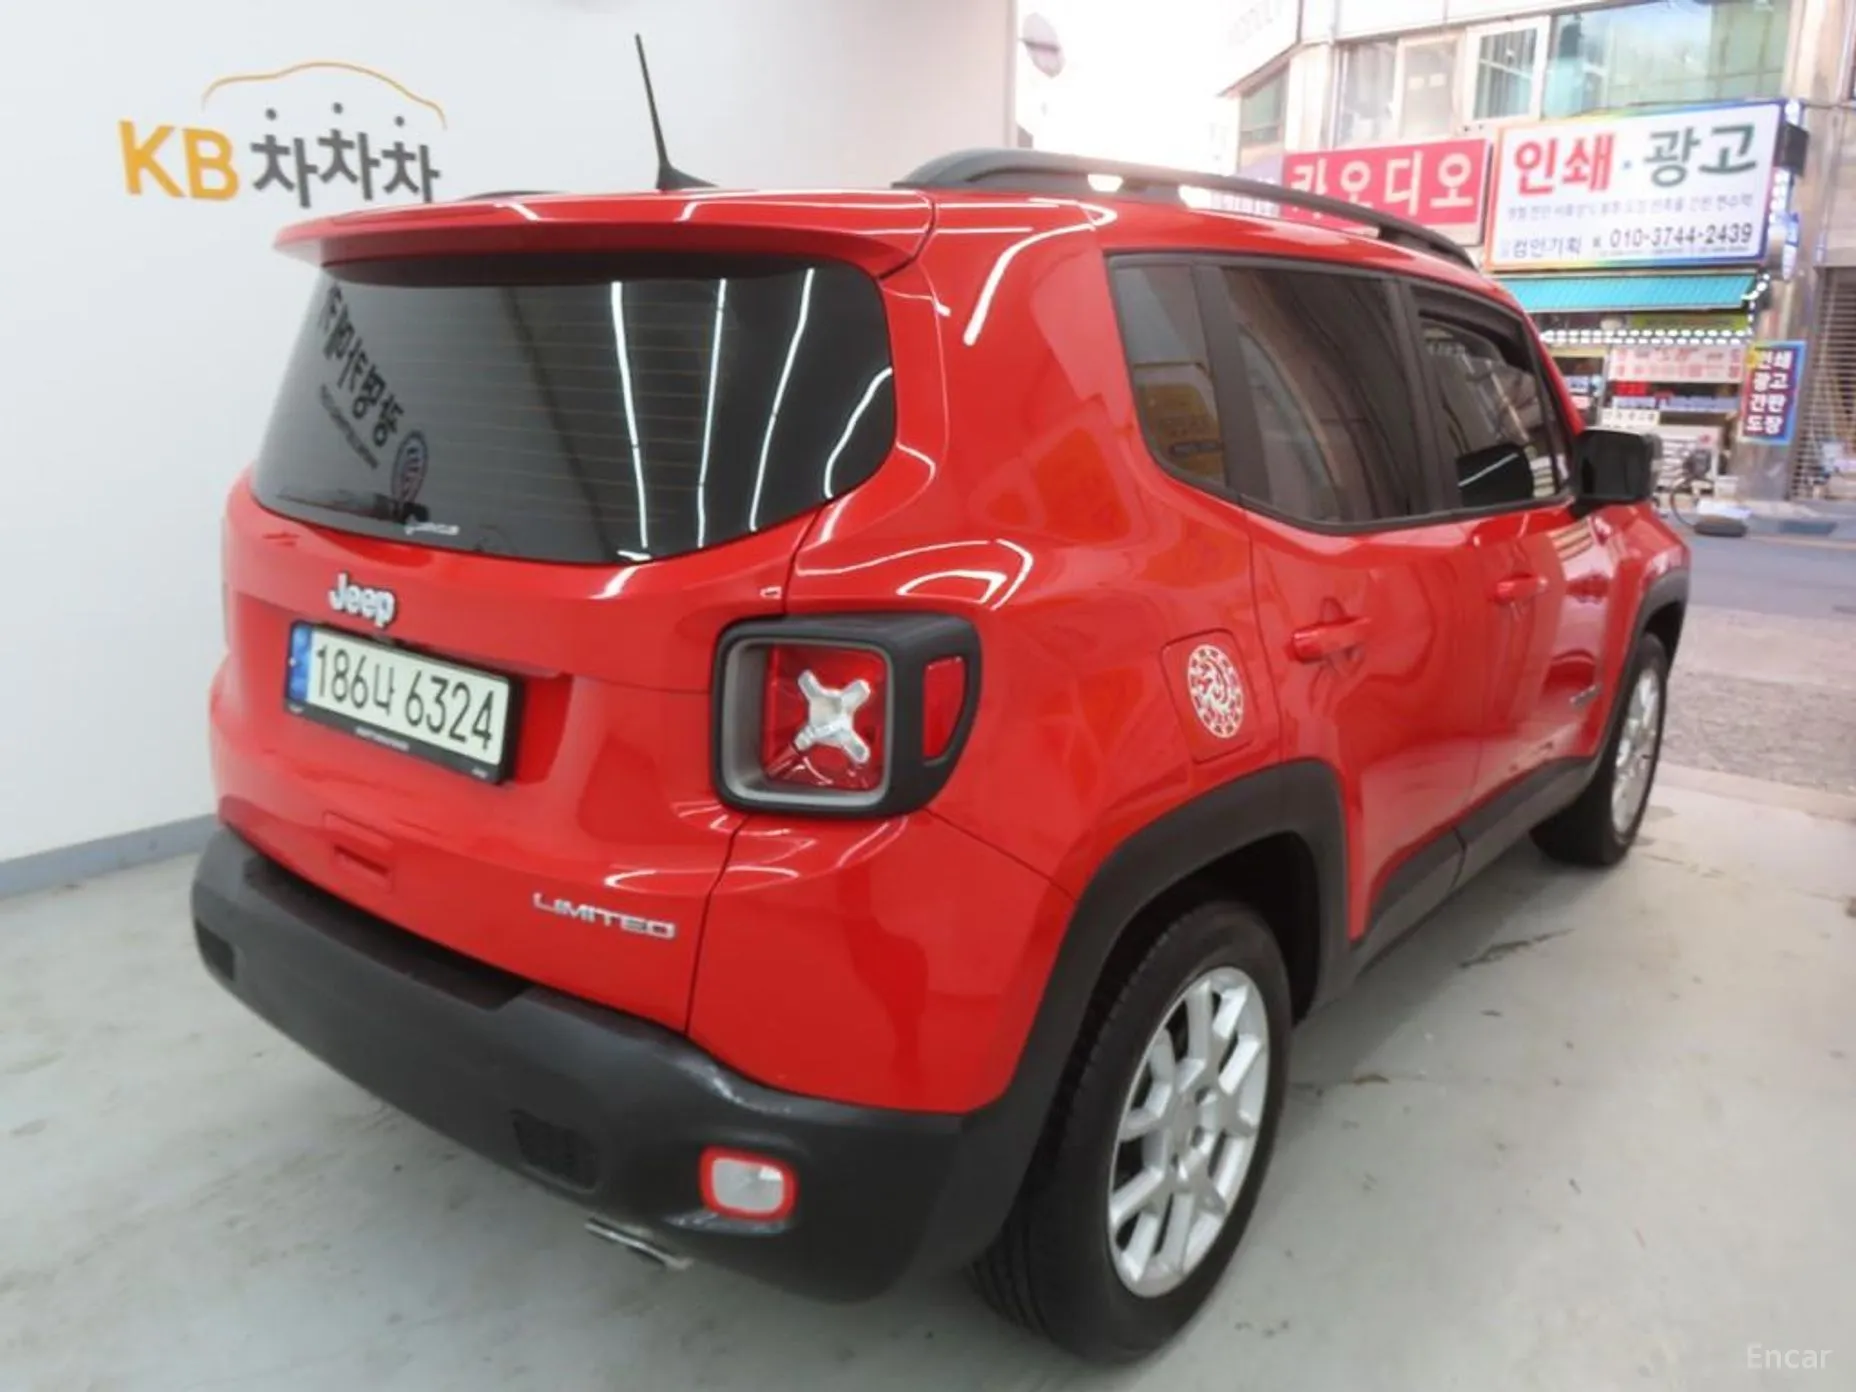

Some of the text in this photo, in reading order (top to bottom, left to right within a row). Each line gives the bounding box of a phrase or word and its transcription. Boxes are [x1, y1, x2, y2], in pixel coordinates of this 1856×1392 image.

[118, 101, 442, 209] KB 차차차
[1514, 123, 1758, 196] 인쇄 광고
[327, 572, 396, 628] Jeep
[316, 644, 494, 750] 186나 6324
[532, 891, 677, 941] LIMITED
